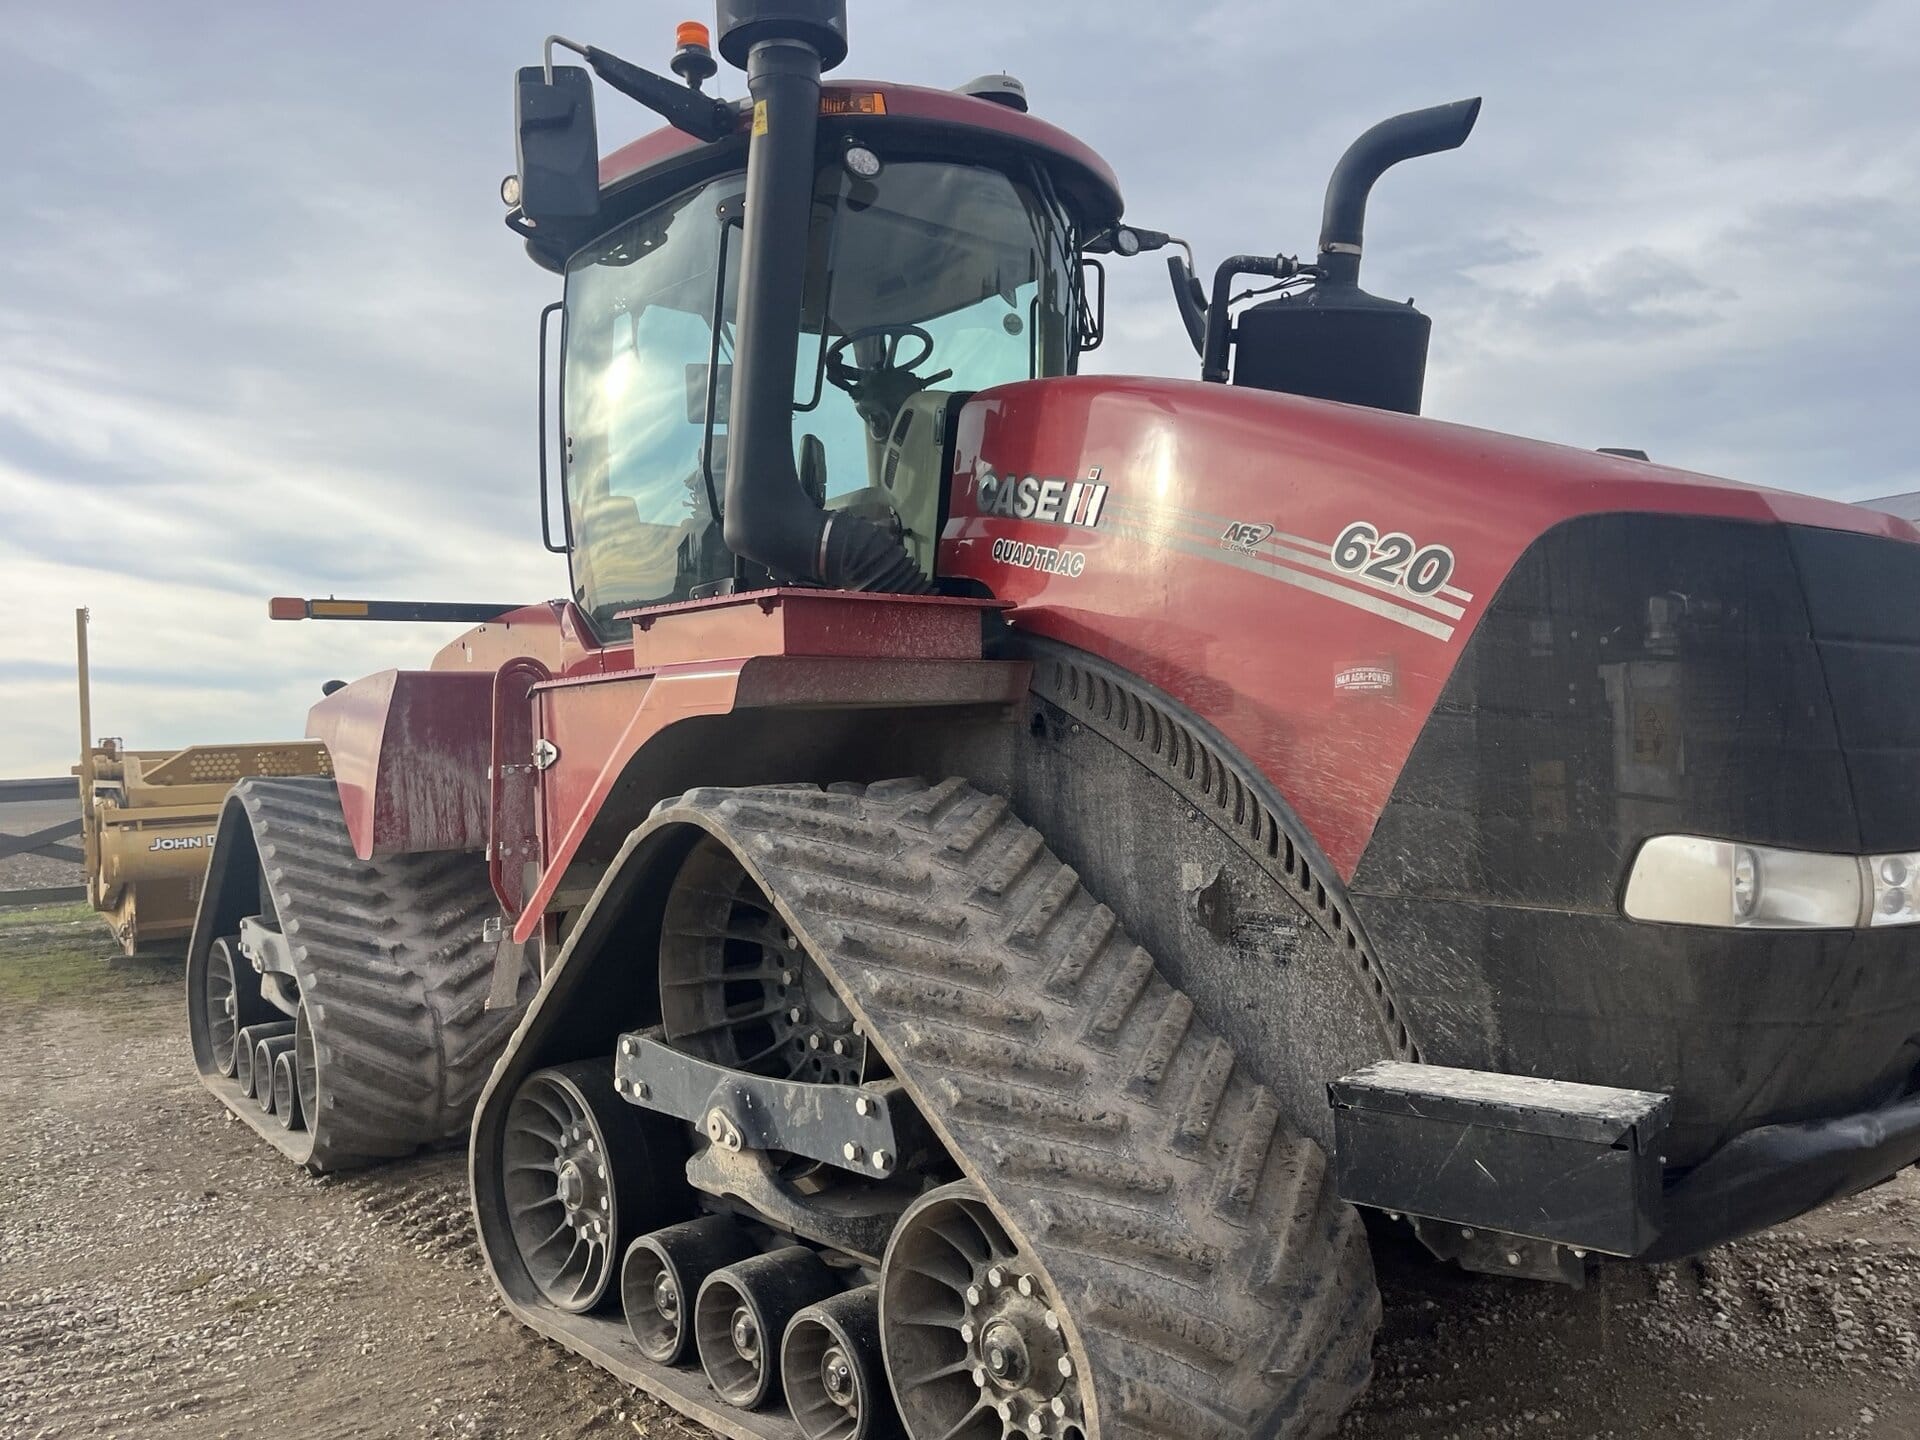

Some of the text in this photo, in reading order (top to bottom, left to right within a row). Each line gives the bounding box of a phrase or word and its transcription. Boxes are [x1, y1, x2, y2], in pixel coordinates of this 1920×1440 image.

[977, 472, 1066, 522] CASE
[1220, 521, 1263, 546] AFS
[992, 538, 1086, 577] QUADTRAC
[1330, 521, 1456, 597] 620
[149, 836, 203, 851] JOHN
